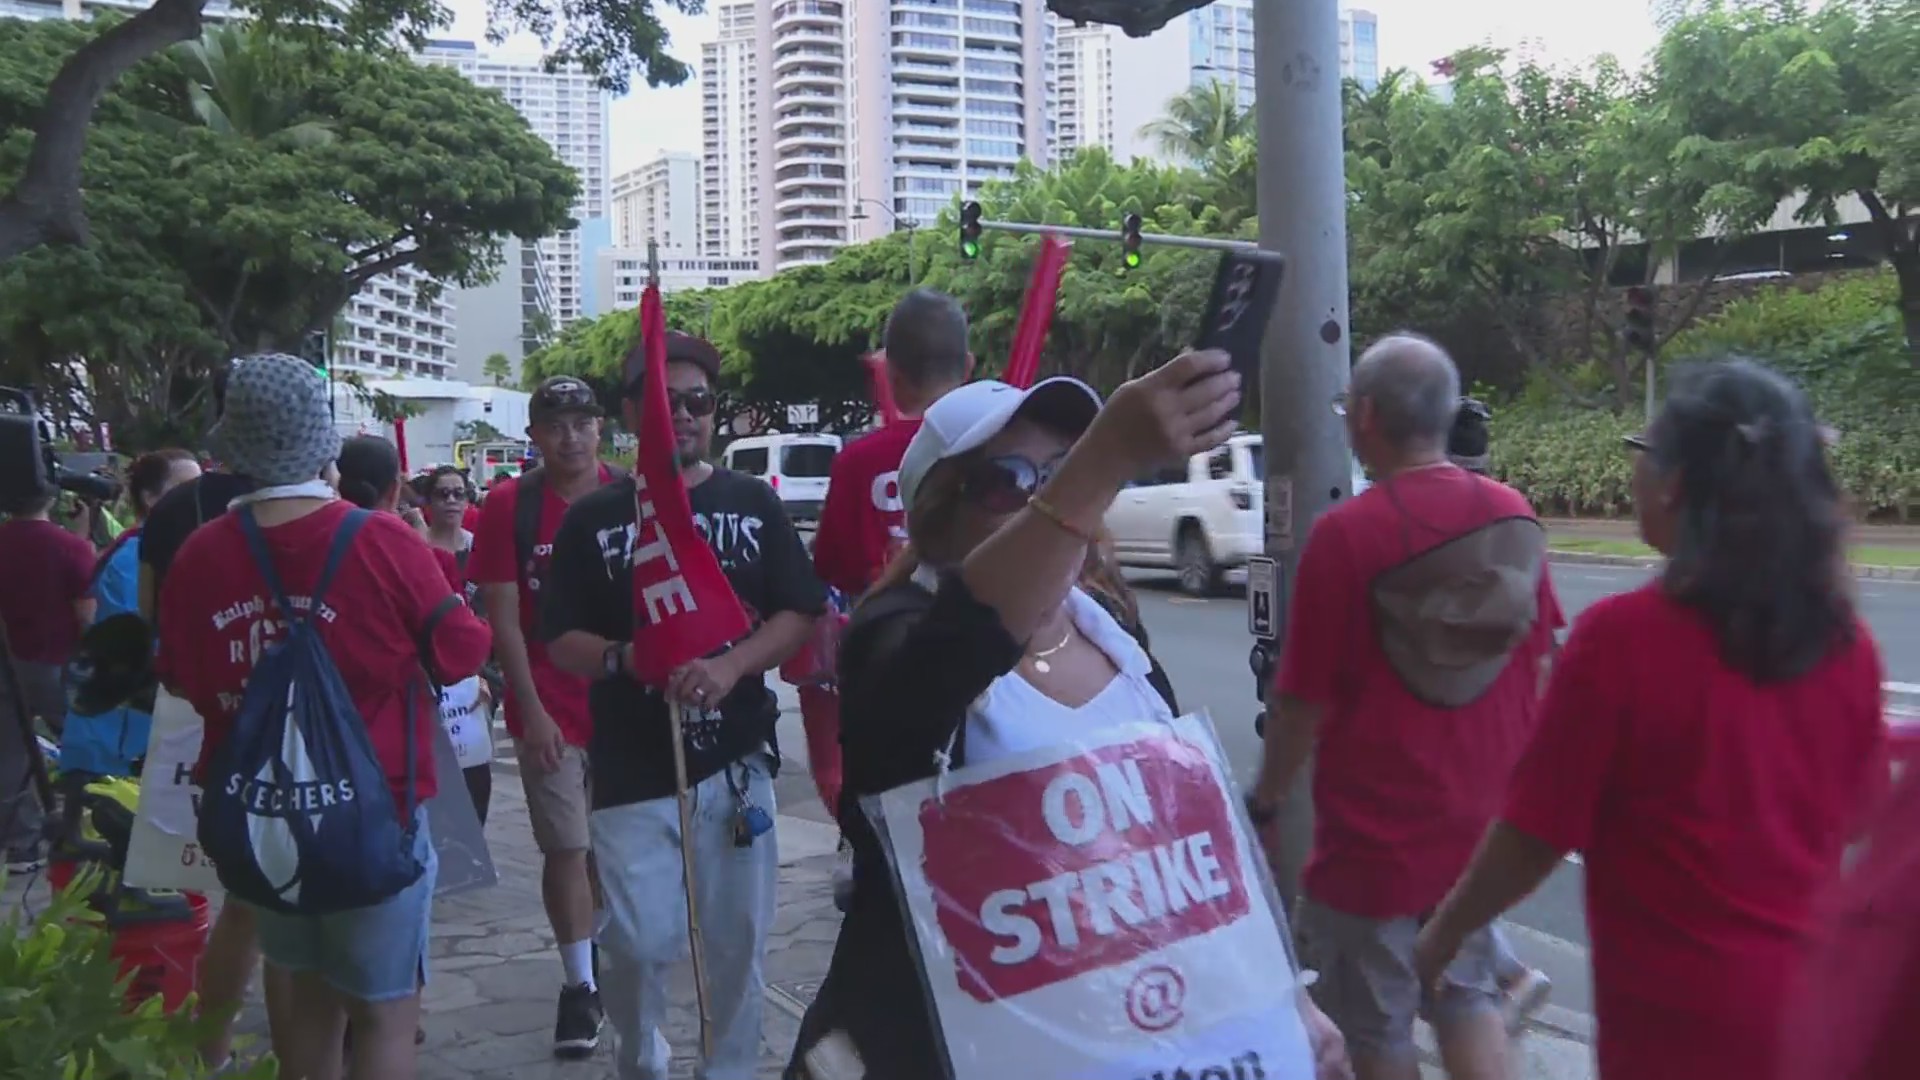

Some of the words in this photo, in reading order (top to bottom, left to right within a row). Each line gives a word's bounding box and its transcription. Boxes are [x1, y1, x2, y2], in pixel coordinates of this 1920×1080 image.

[1041, 758, 1154, 846] ON
[980, 831, 1231, 966] STRIKE
[1126, 965, 1184, 1032] @
